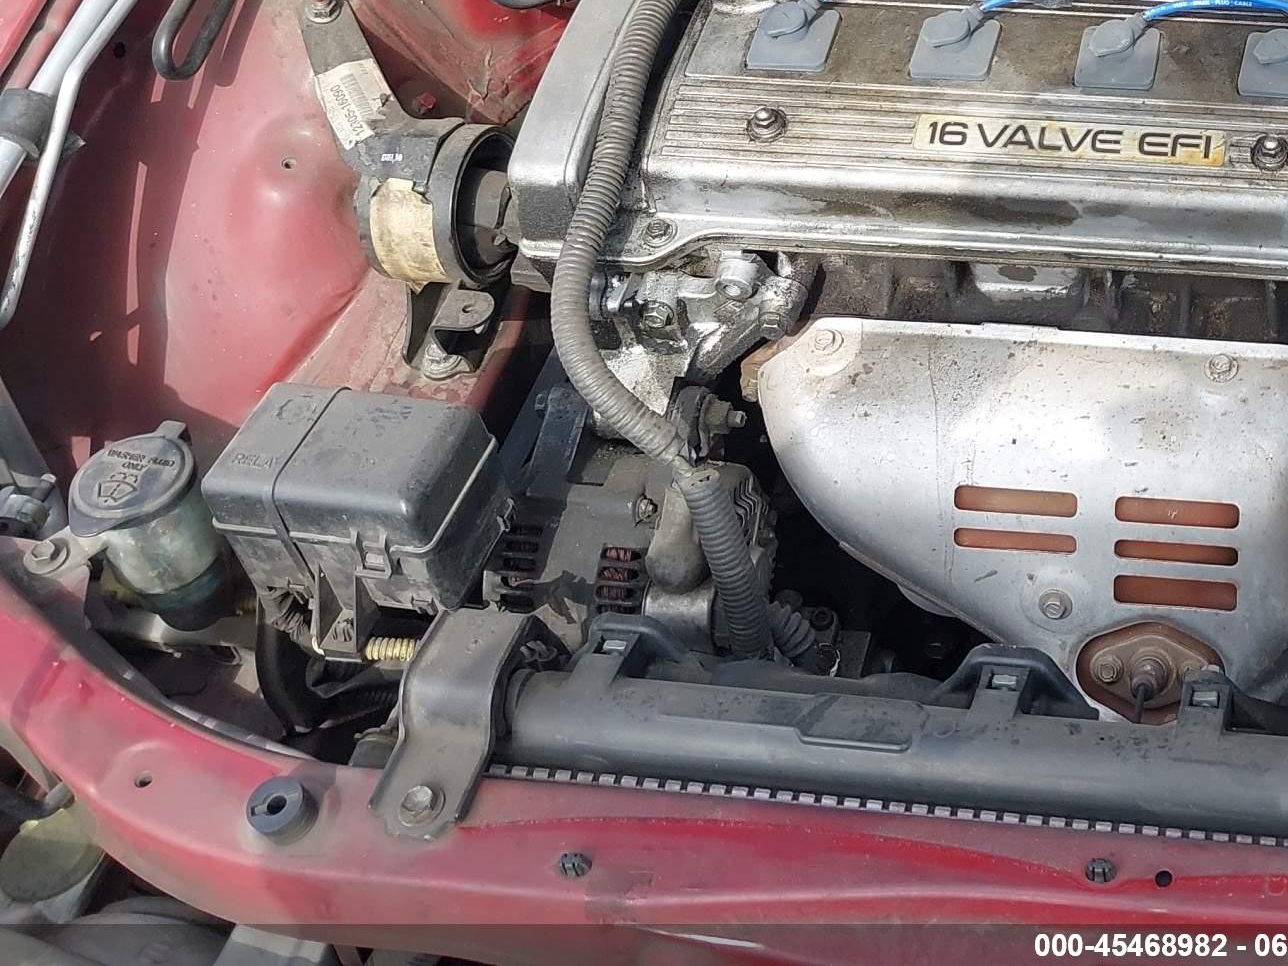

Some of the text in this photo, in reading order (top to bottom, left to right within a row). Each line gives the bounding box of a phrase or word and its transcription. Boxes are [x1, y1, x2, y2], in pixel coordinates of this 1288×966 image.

[928, 121, 1212, 160] 16 VALVE EFI
